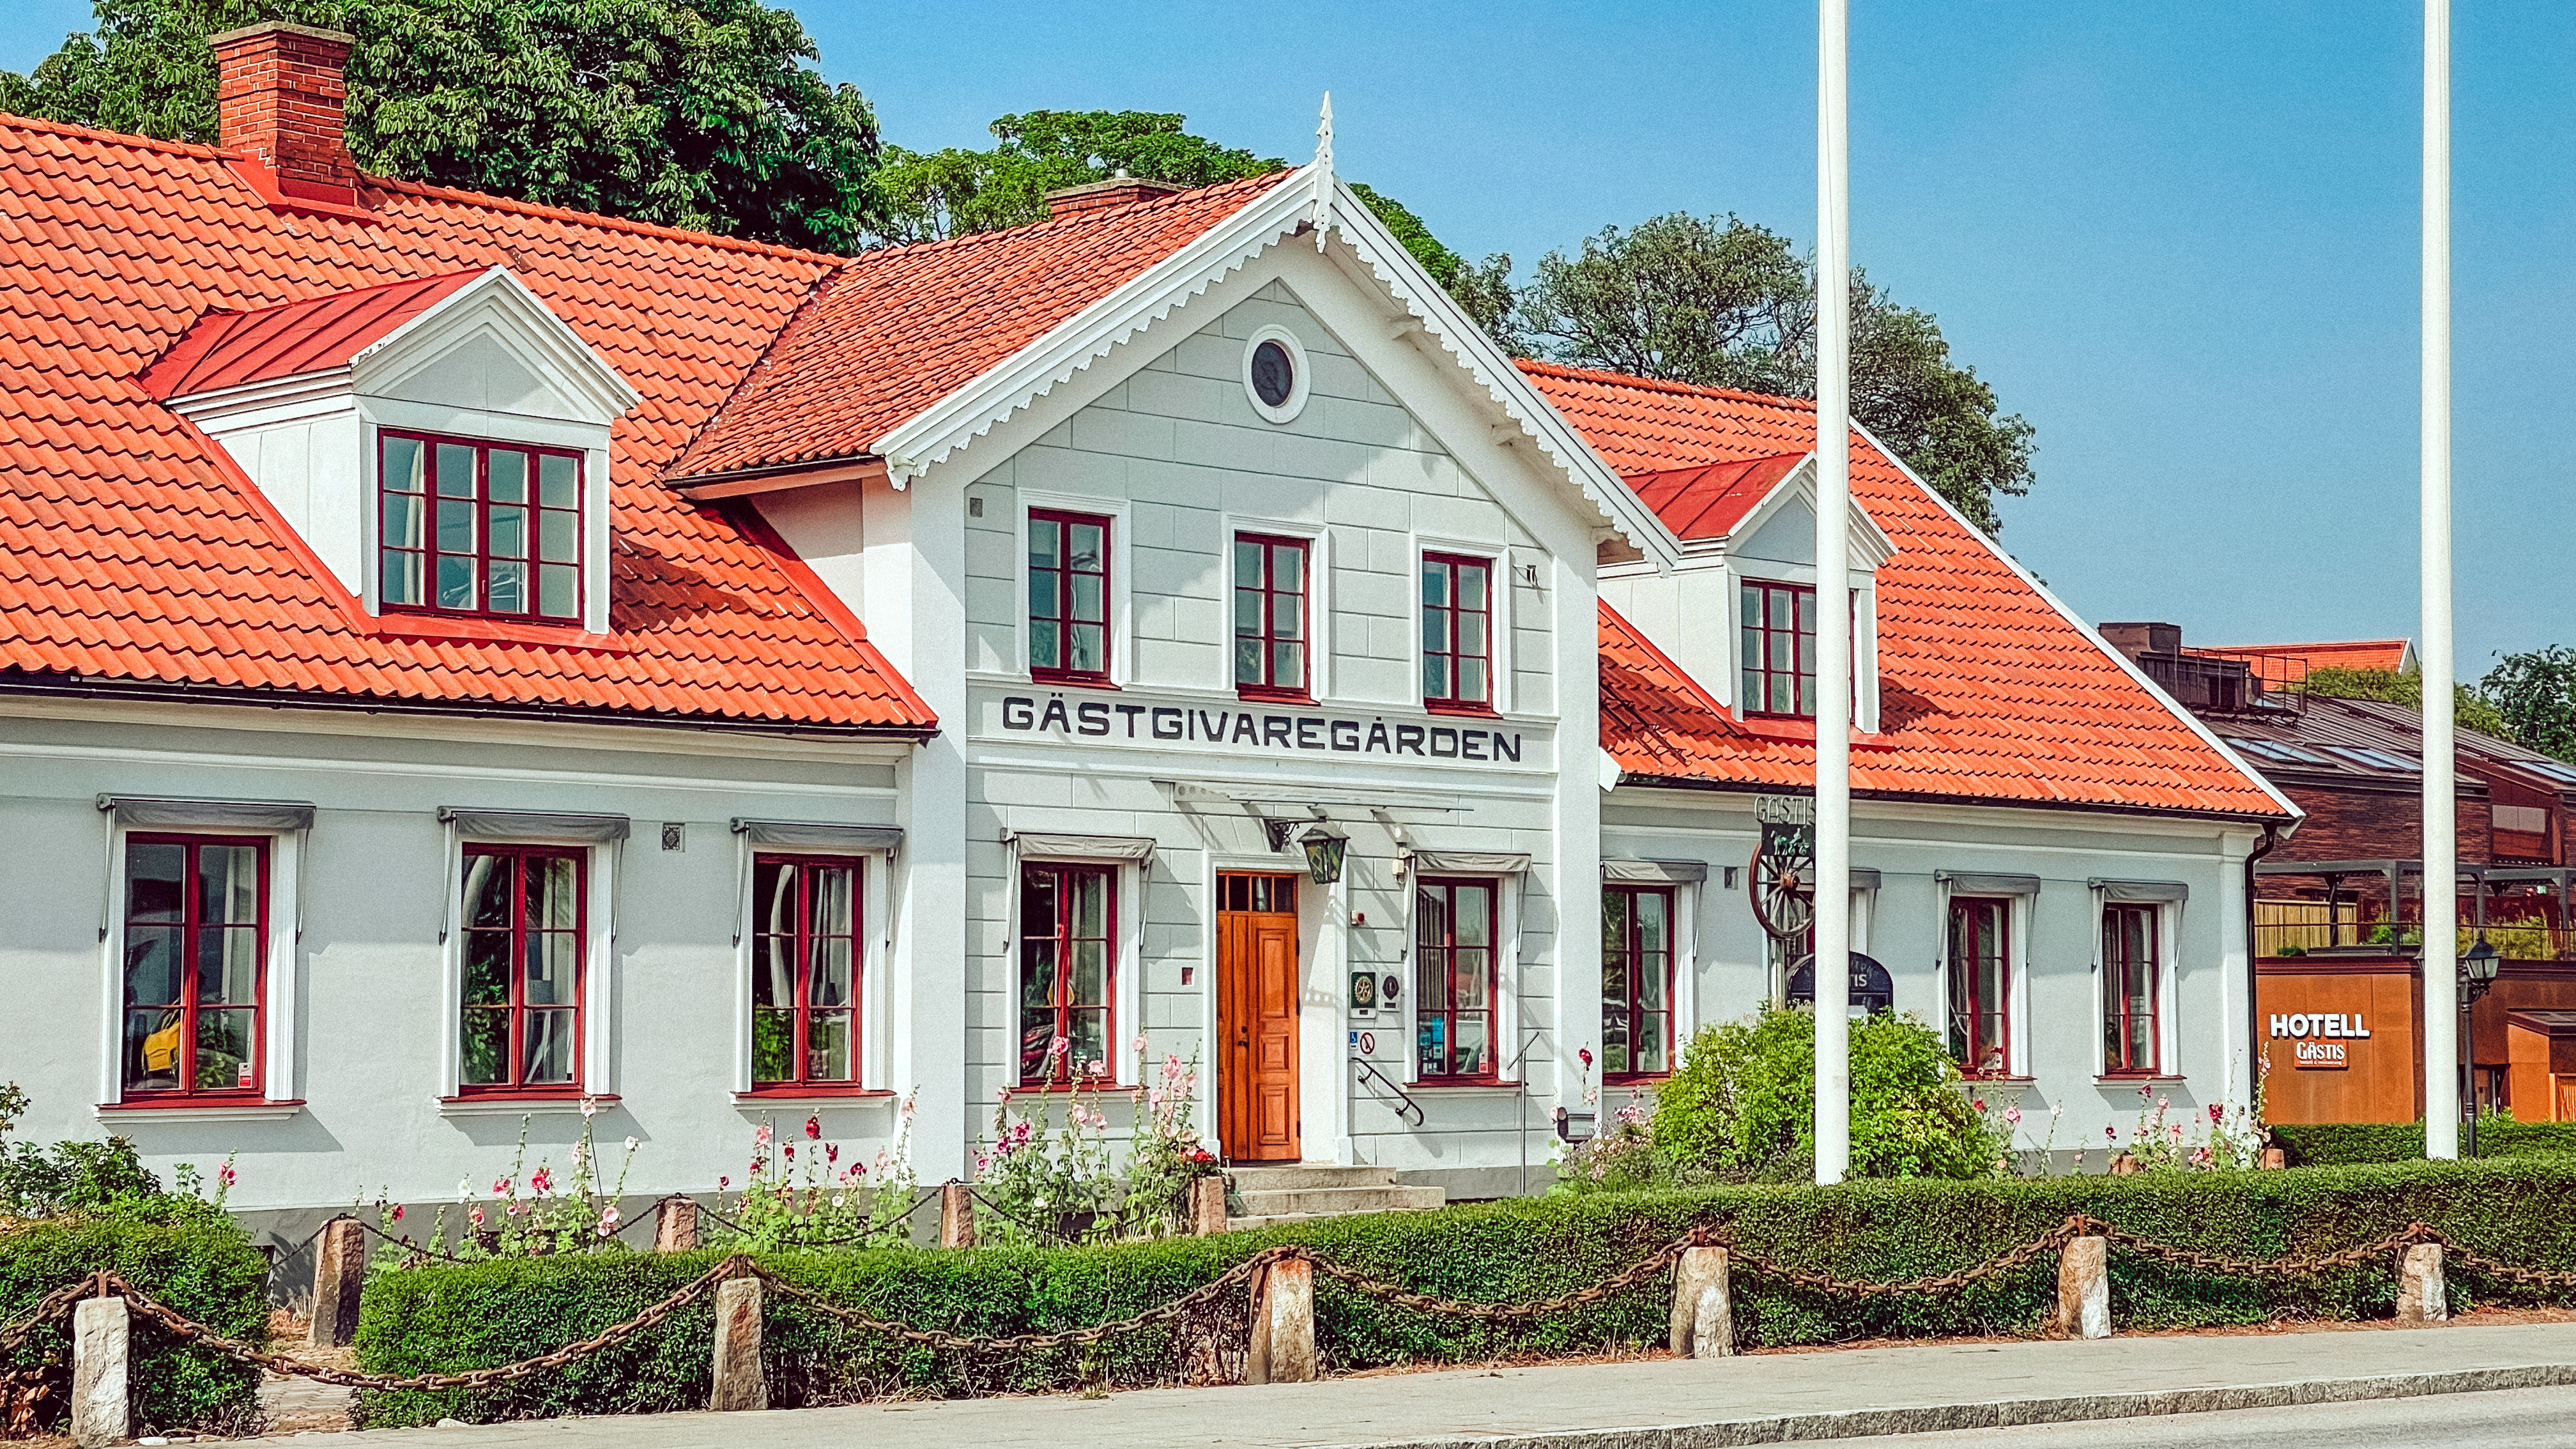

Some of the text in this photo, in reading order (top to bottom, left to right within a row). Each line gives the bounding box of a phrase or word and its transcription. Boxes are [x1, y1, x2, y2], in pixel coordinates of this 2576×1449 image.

[1002, 693, 1521, 762] GÄSTGIVAREGÅRDEN
[2270, 1013, 2370, 1037] HOTELL
[2296, 1041, 2345, 1059] GÄSTIS
